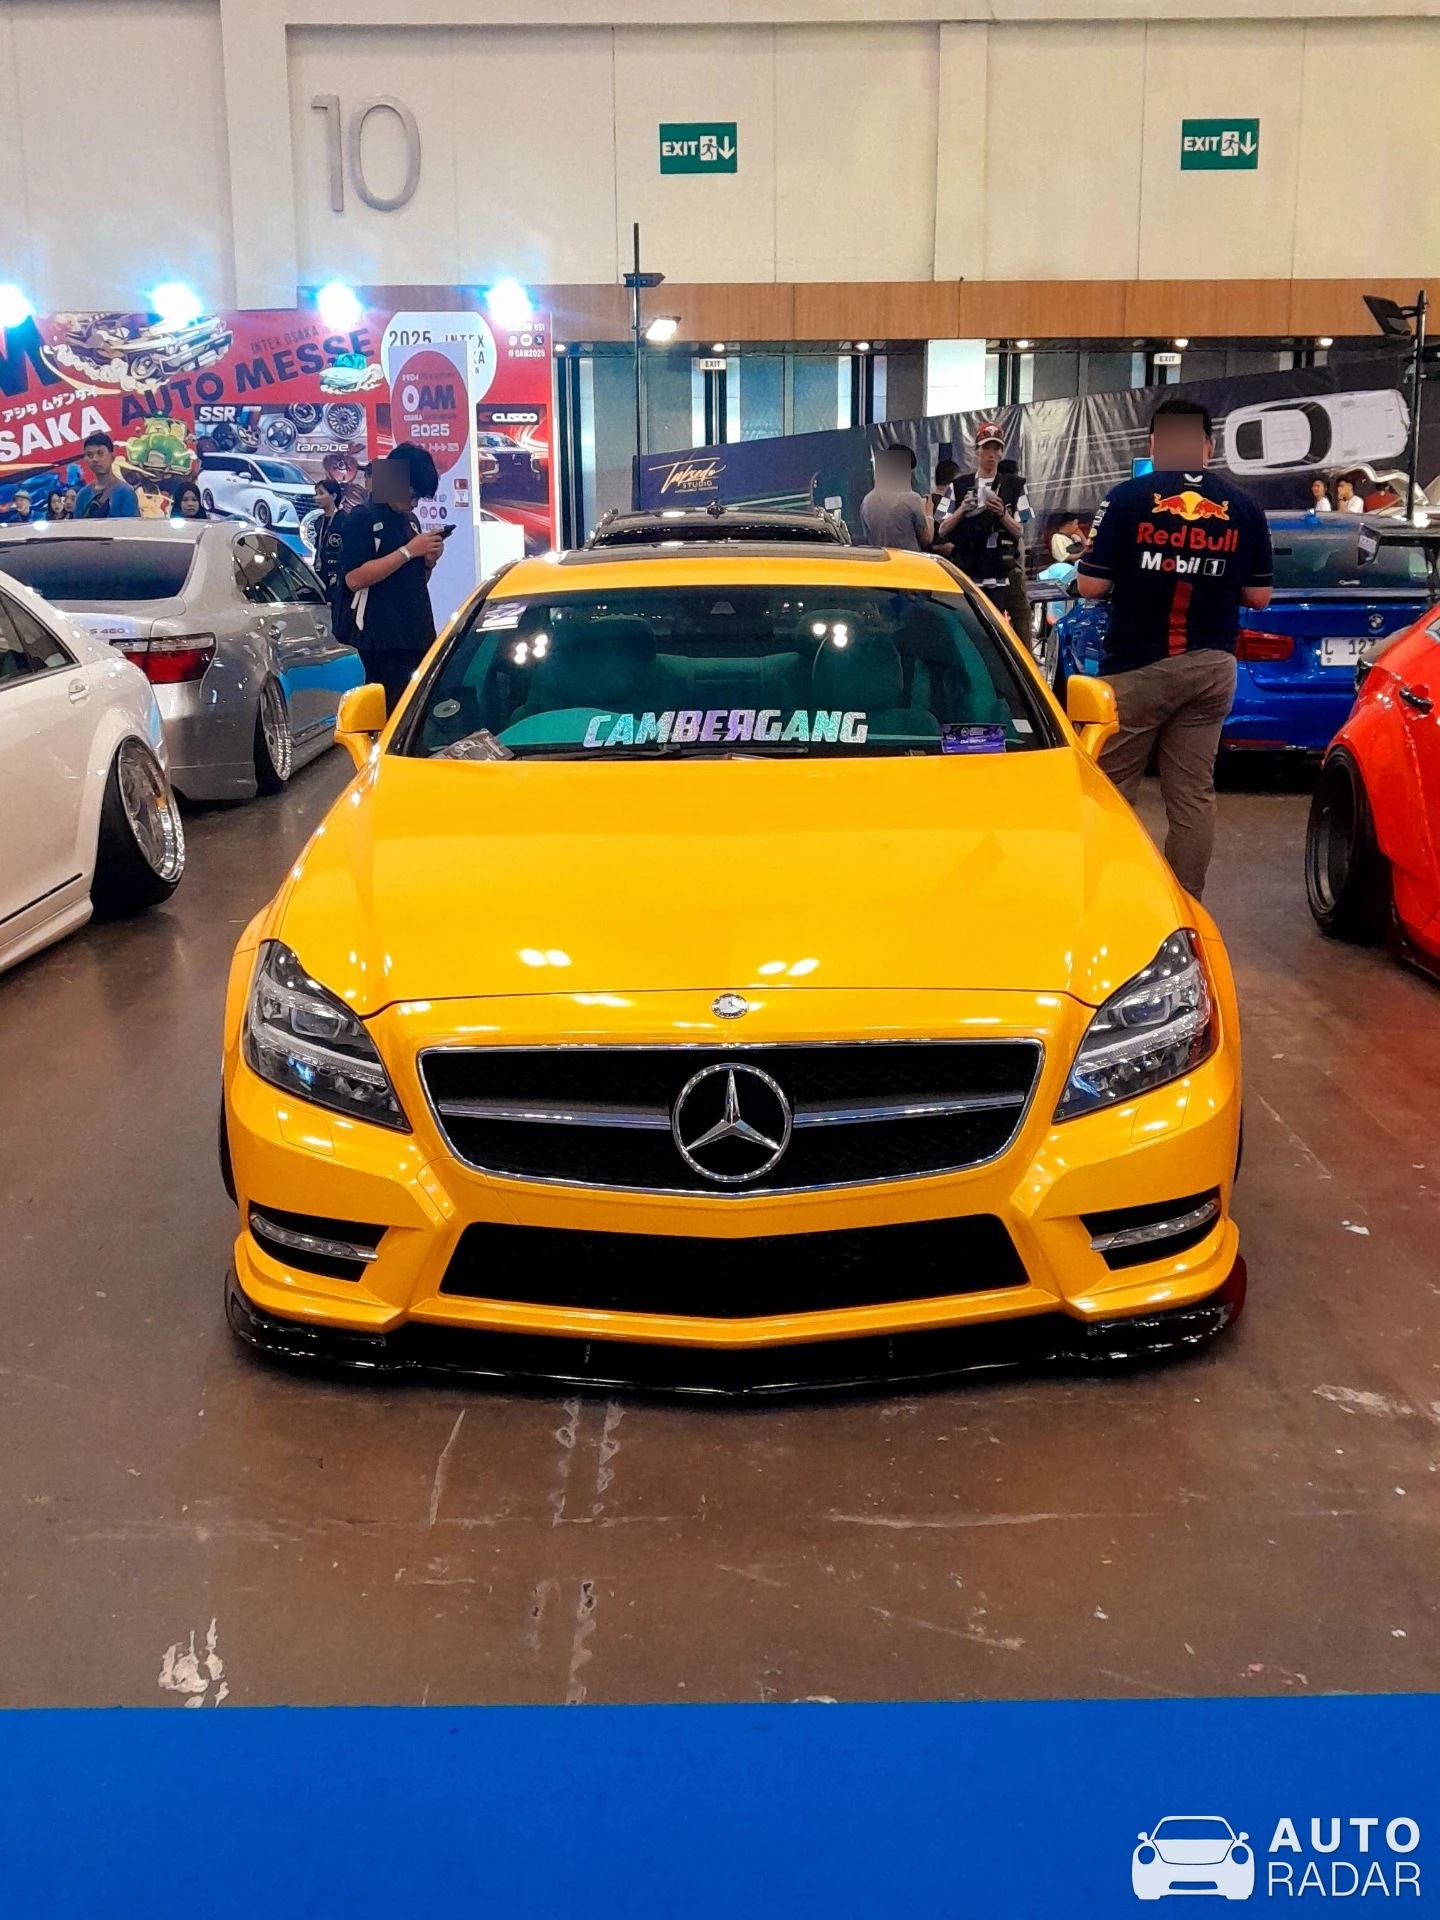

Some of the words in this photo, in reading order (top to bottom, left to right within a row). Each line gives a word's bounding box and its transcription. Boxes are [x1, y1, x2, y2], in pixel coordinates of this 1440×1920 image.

[661, 141, 699, 156] EXIT
[1183, 136, 1220, 152] EXIT
[310, 94, 421, 213] 10
[389, 330, 432, 347] 2025
[704, 360, 721, 368] EXIT
[1159, 355, 1176, 363] EXIT
[121, 372, 224, 428] AUTO
[235, 328, 374, 393] MESSE
[401, 384, 456, 413] OAM
[198, 405, 237, 422] SSR
[491, 412, 539, 423] CUSCO
[410, 423, 451, 437] 2025
[296, 442, 349, 452] tanabe
[682, 480, 713, 489] STUDIO
[1136, 522, 1188, 548] Red
[1189, 528, 1239, 552] Bull
[1141, 551, 1201, 575] Mobil
[1324, 639, 1334, 656] L
